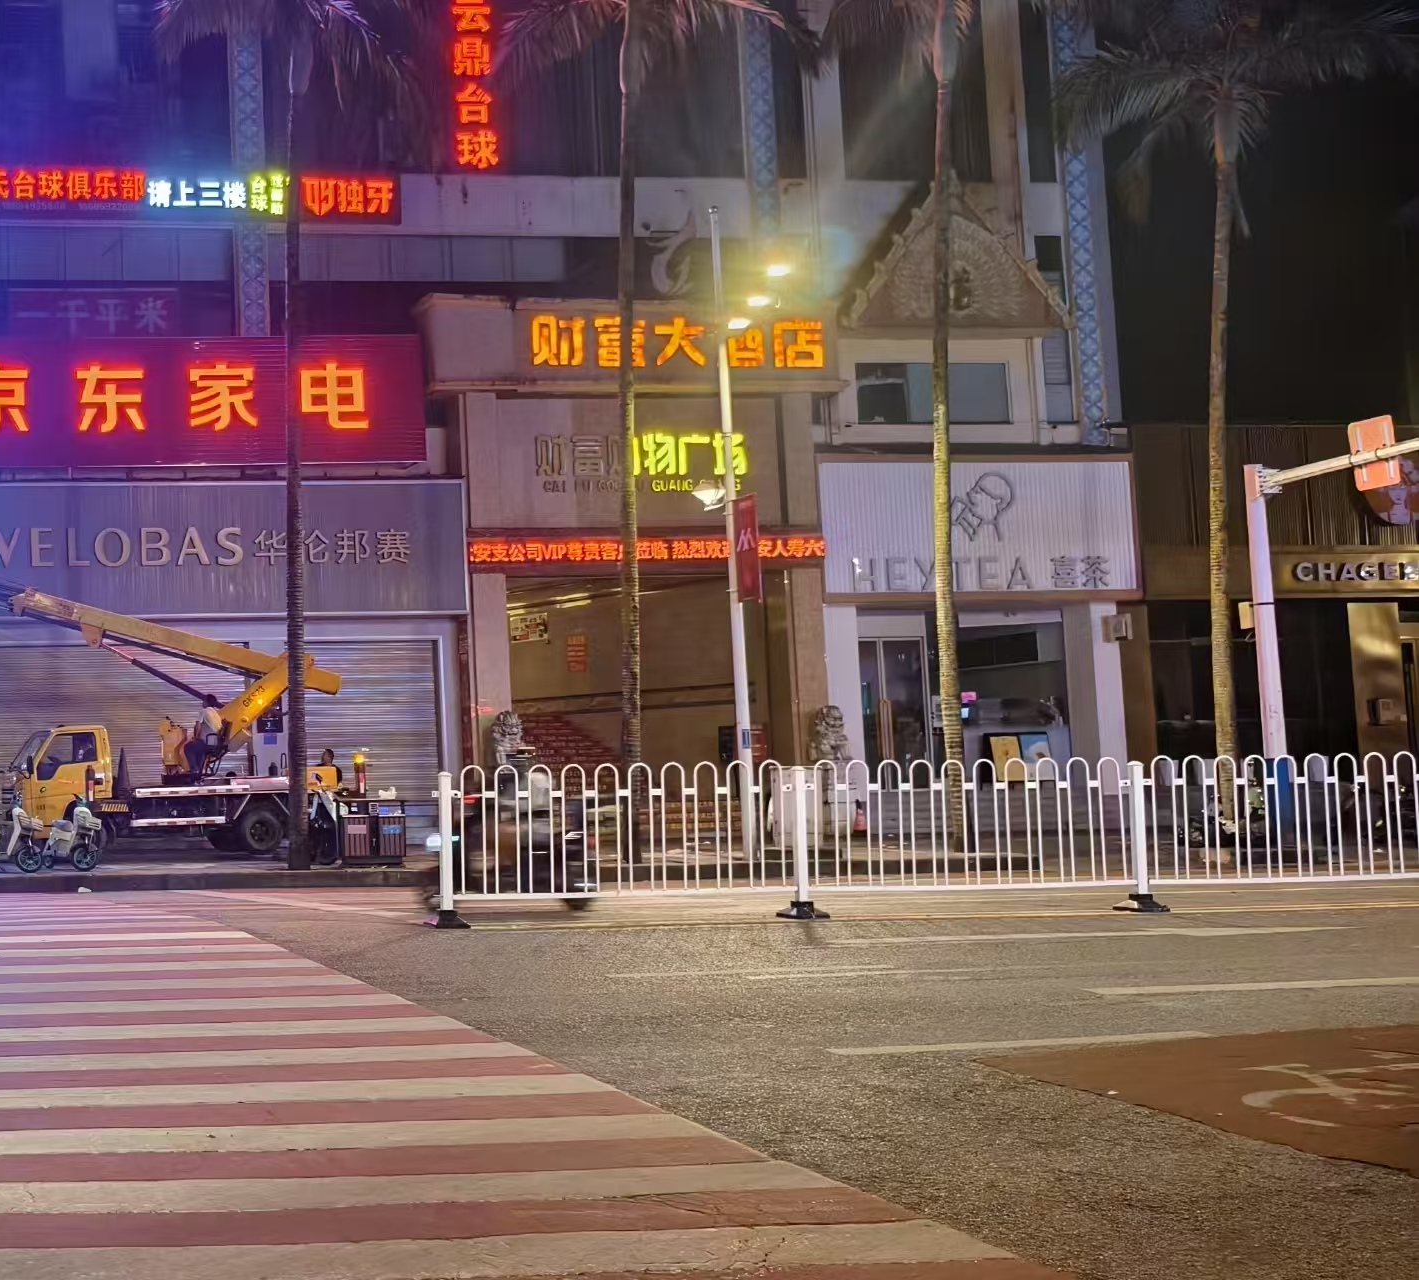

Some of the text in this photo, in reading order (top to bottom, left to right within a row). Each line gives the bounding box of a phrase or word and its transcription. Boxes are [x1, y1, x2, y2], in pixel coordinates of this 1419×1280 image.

[453, 0, 499, 169] 云鼎台球
[147, 180, 246, 208] 请上三楼
[250, 176, 268, 211] 台球
[12, 296, 170, 331] 一千平米
[253, 529, 411, 565] 华伦邦赛
[1050, 555, 1109, 588] 喜茶
